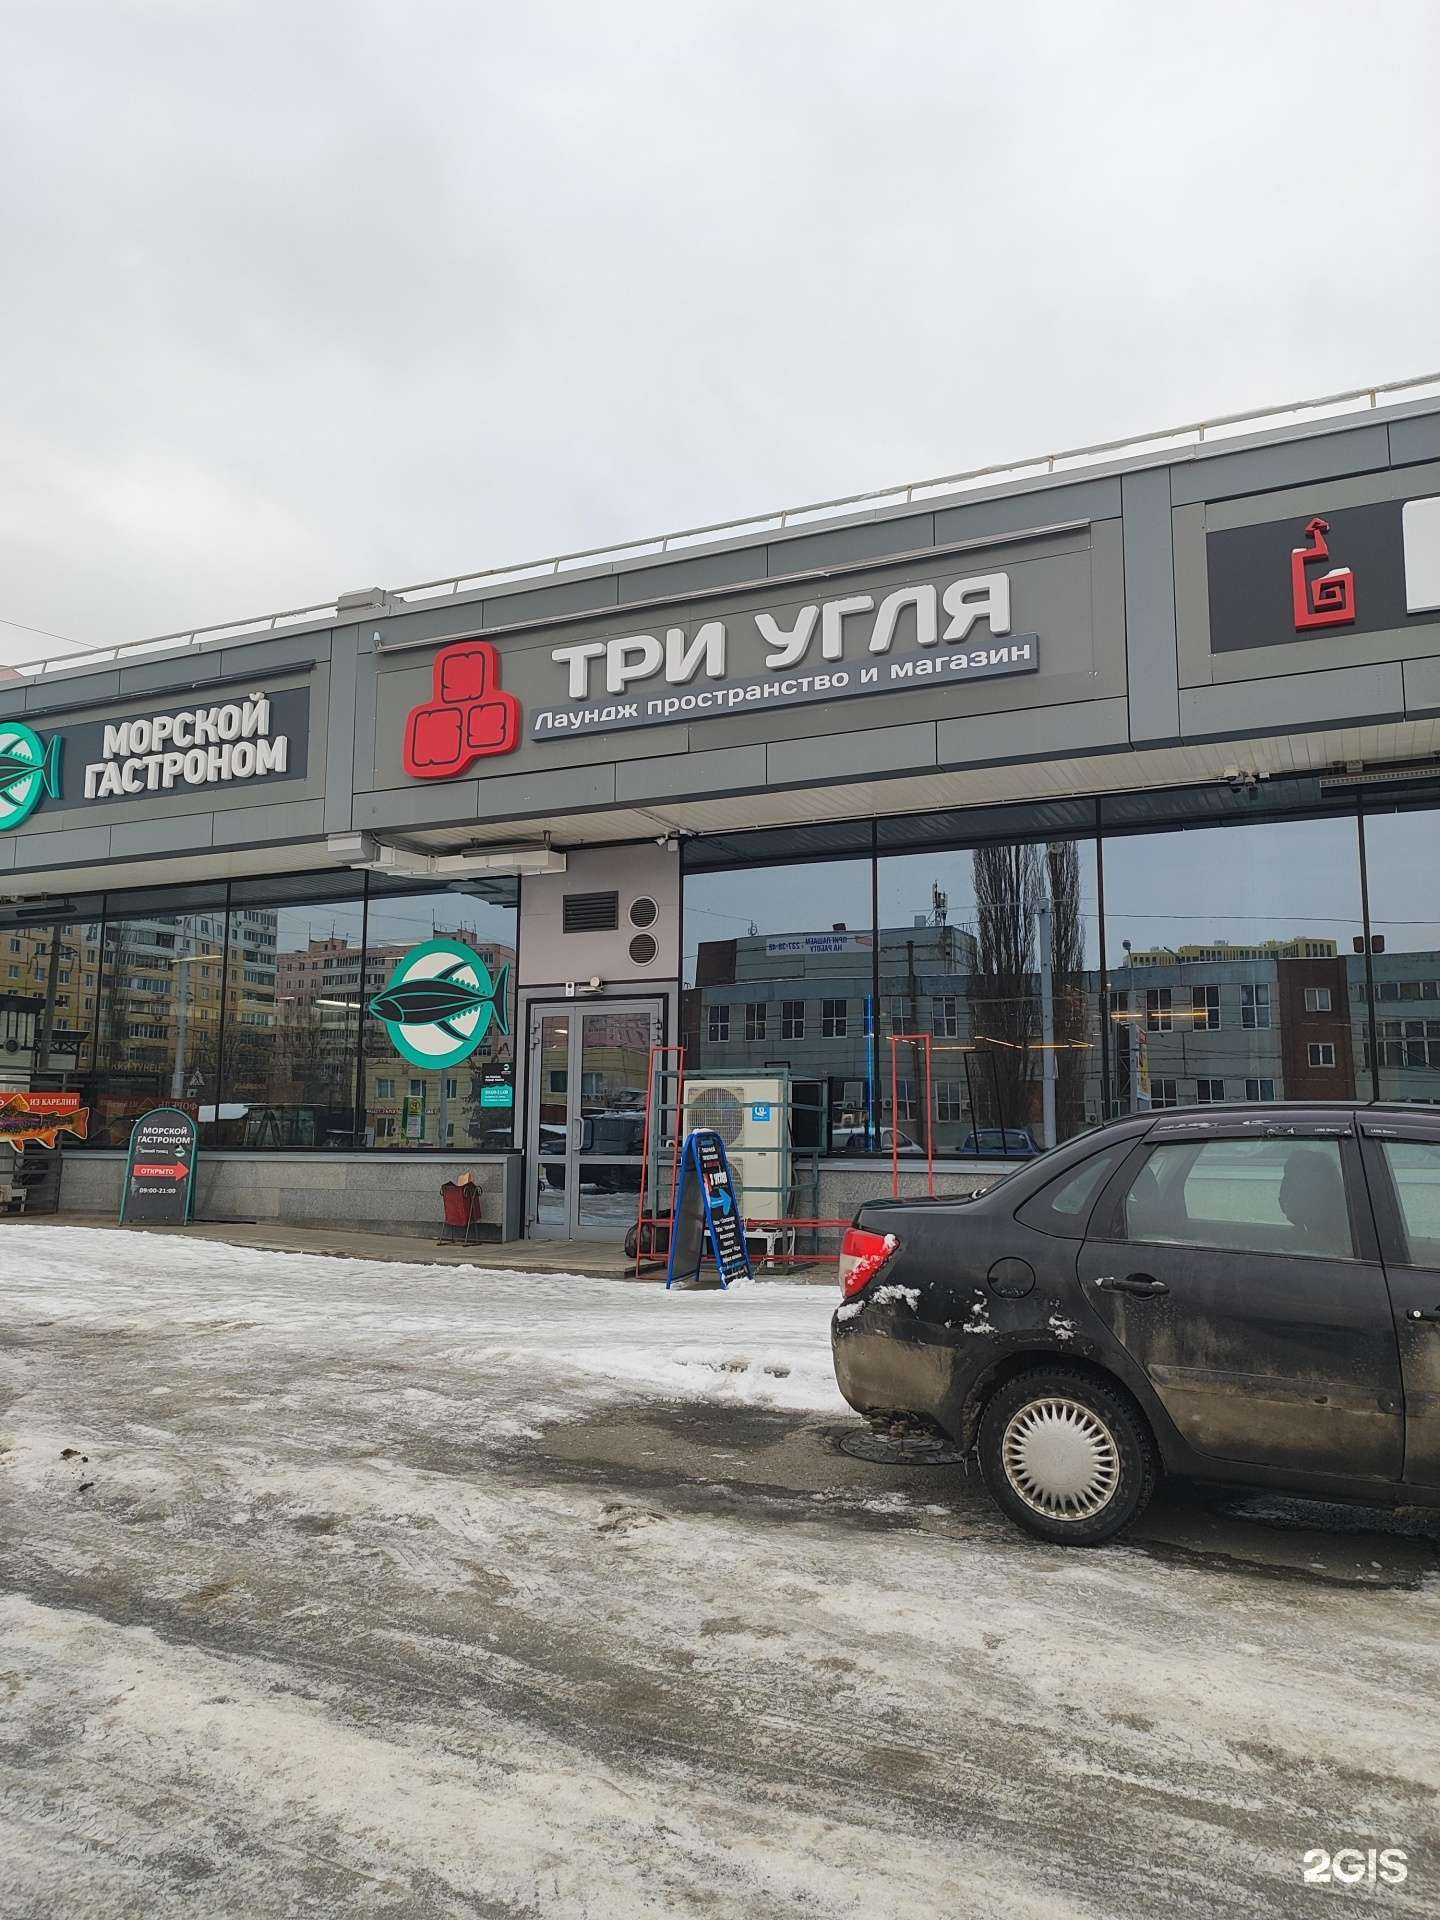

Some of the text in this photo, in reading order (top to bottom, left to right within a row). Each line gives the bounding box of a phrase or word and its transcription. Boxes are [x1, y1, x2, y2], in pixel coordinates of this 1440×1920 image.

[551, 572, 1011, 699] ТРИ УГЛЯ
[534, 644, 1031, 731] Лаундж пространство и магазин
[102, 691, 271, 760] МОРСКОЙ
[84, 735, 288, 799] ГАСТРОНОМ
[137, 1135, 191, 1144] ГАСТРОНОМ
[142, 1126, 188, 1136] МОРСКОЙ
[140, 1167, 175, 1175] ОТКРЫТО
